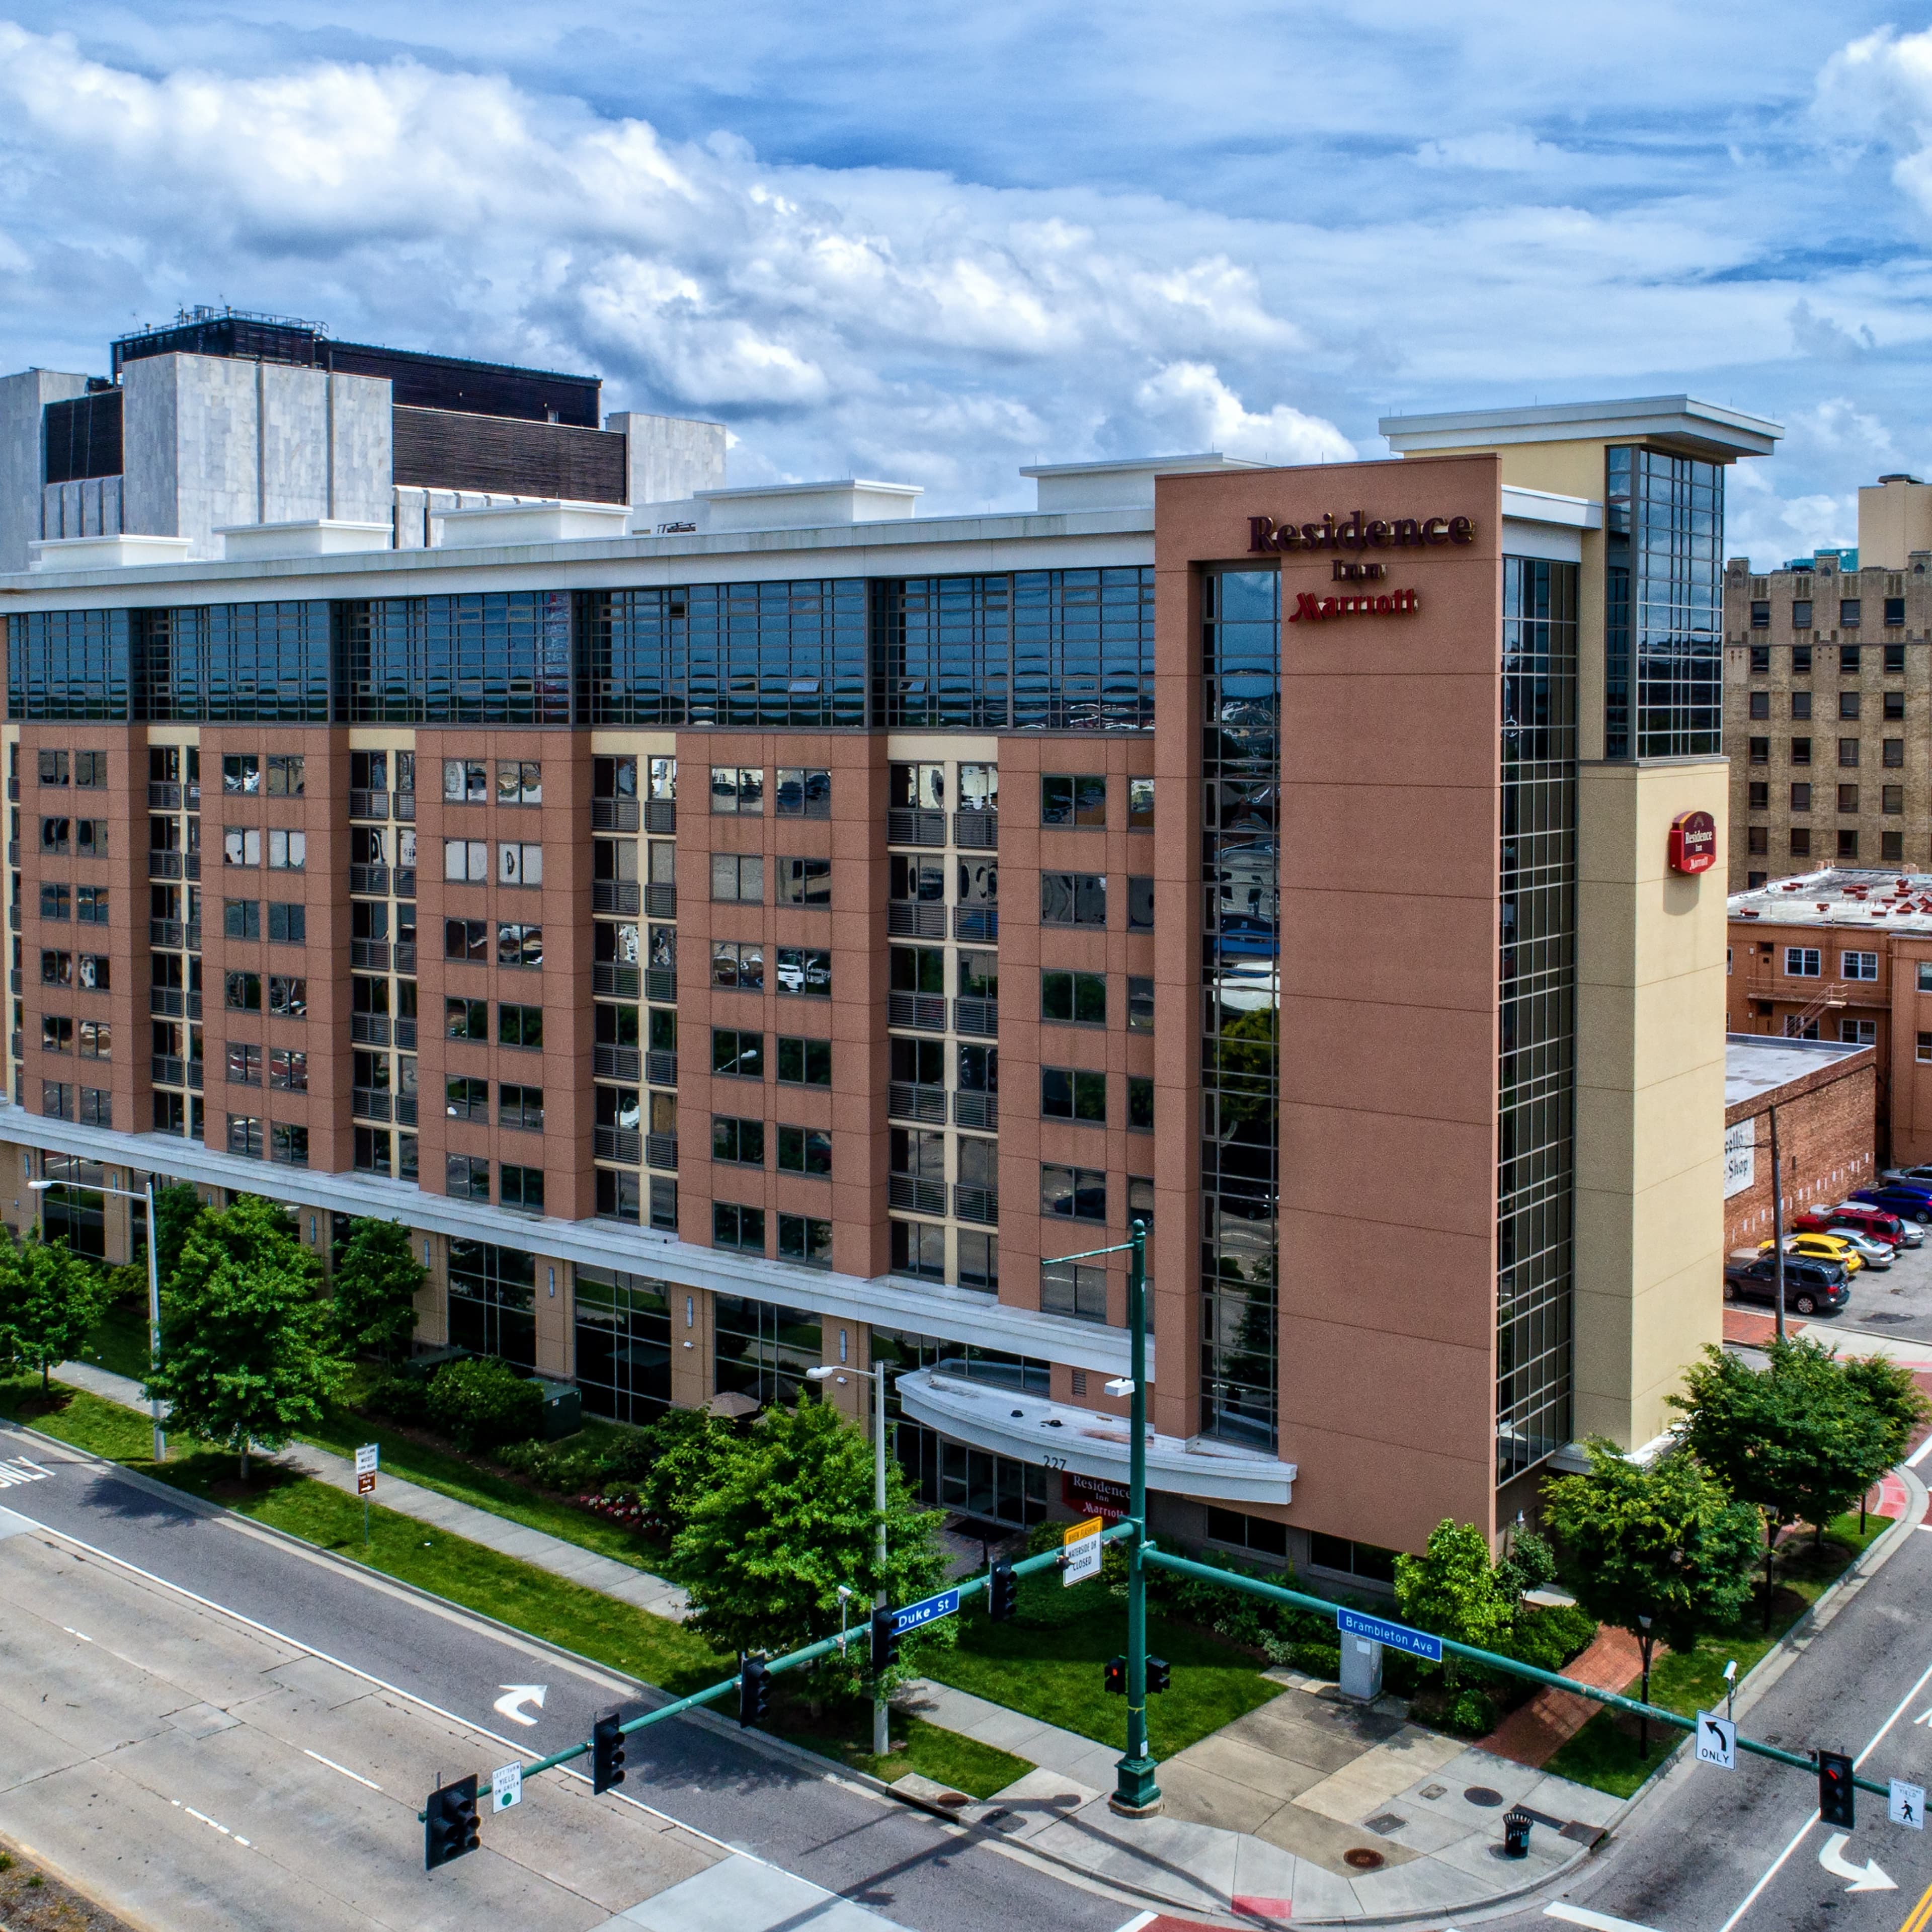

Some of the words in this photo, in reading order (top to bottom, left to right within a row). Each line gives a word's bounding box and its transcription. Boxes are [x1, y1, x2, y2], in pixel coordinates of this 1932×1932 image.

[1247, 509, 1475, 552] Residence
[1331, 559, 1386, 582] Inn
[1288, 588, 1418, 622] Marriott
[1685, 830, 1712, 845] Residence
[1729, 1159, 1748, 1178] Shop
[1043, 1455, 1067, 1471] 227
[1073, 1475, 1131, 1499] Residence
[1096, 1493, 1109, 1502] Inn
[1068, 1543, 1090, 1558] WATERSIDE
[1091, 1540, 1097, 1550] DR
[1073, 1556, 1092, 1571] CLOSED
[899, 1608, 930, 1628] Duke
[938, 1598, 949, 1612] St
[1346, 1616, 1408, 1645] Brambleton
[1413, 1638, 1432, 1653] Ave
[1702, 1748, 1729, 1763] ONLY
[494, 1769, 505, 1779] LEFT
[500, 1774, 515, 1785] YIELD
[1899, 1789, 1916, 1798] YIELD
